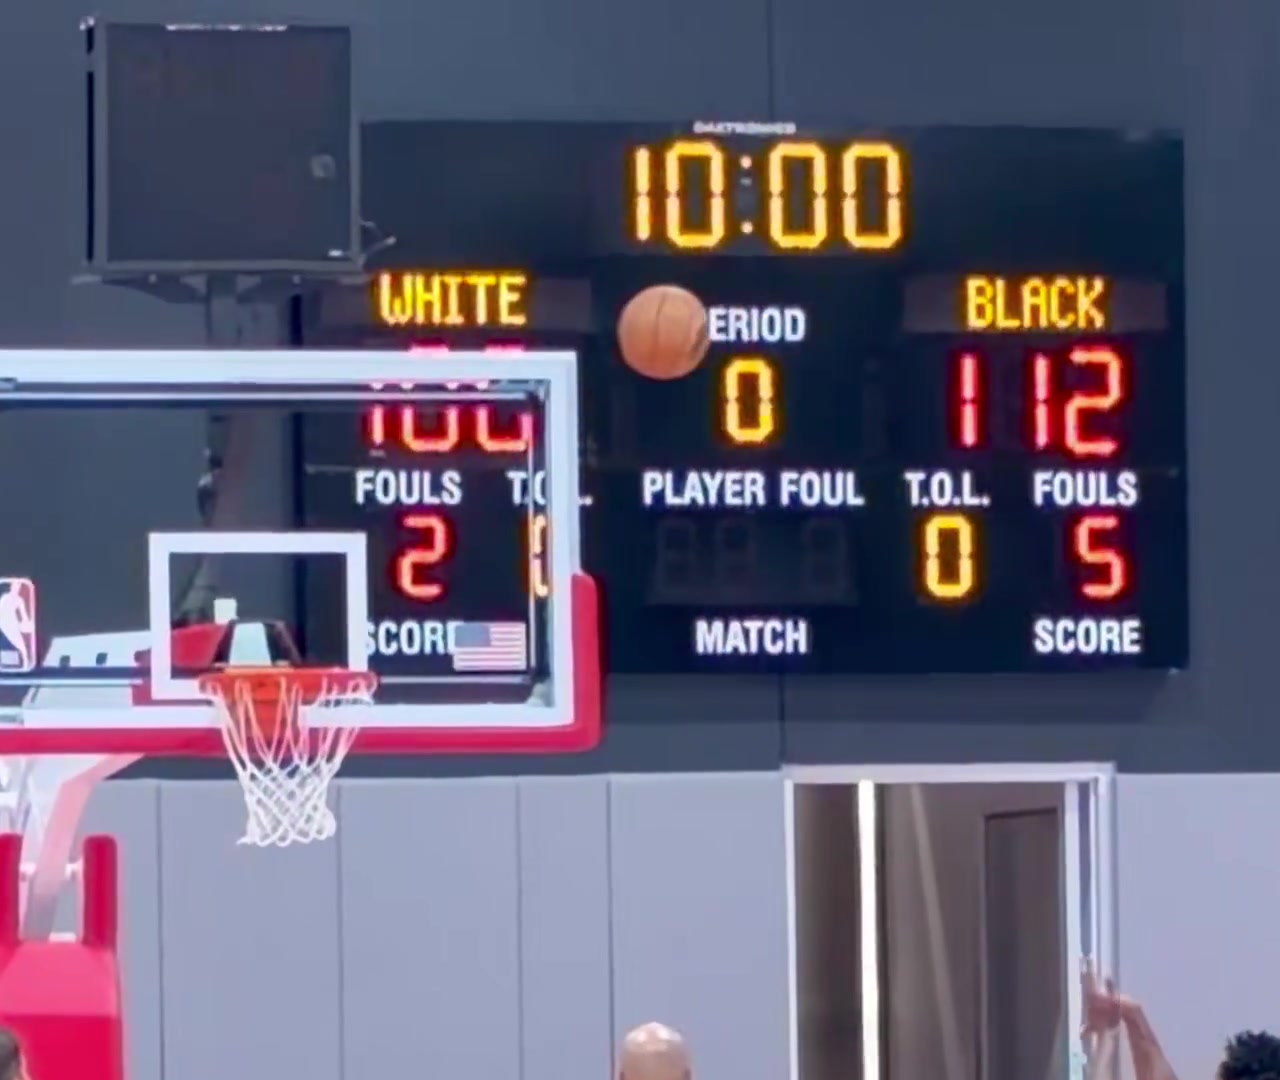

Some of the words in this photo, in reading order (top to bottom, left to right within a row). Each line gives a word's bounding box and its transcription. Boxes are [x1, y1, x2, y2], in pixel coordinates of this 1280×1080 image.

[634, 141, 901, 248] 10:00
[378, 273, 527, 325] WHITE
[708, 307, 806, 342] ERIOD
[966, 277, 1105, 329] BLACK
[725, 358, 774, 444] 0
[959, 345, 1123, 456] 112
[355, 470, 463, 505] FOULS
[642, 471, 767, 507] PLAYER
[779, 471, 866, 507] FOUL
[904, 471, 991, 506] T.O.L.
[1032, 471, 1138, 506] FOULS
[398, 513, 447, 599] 2
[924, 514, 973, 598] 0
[1074, 514, 1126, 600] 5
[694, 618, 808, 655] MATCH
[1033, 618, 1141, 655] SCORE
